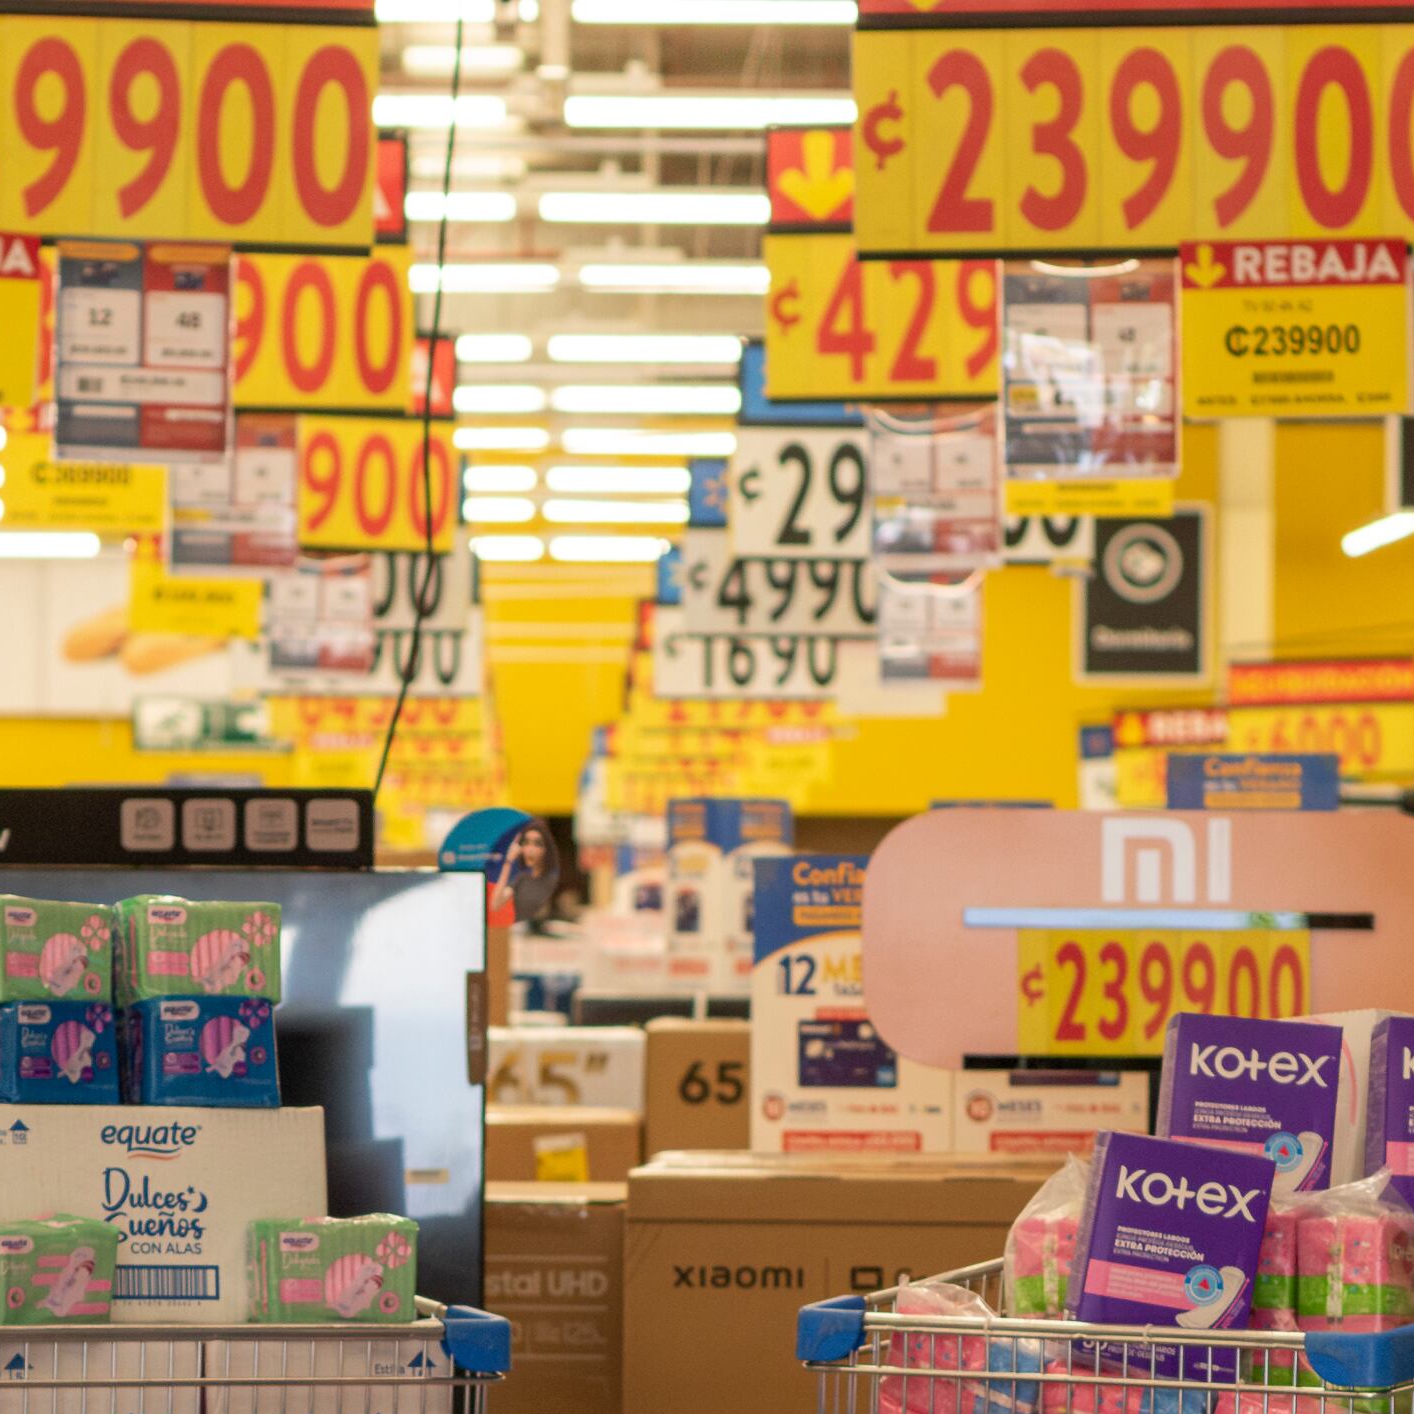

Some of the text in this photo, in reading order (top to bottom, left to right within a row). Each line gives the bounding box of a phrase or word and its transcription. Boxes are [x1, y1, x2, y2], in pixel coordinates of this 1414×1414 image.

[1232, 244, 1400, 283] REBAJA
[779, 954, 818, 996] 12
[679, 1061, 744, 1106] 65
[99, 1120, 198, 1154] equate
[1193, 1114, 1282, 1130] EXTRA PROTECCIÓN
[101, 1167, 190, 1214] Dulces
[130, 1240, 203, 1255] CON ALAS
[1115, 1239, 1205, 1263] EXTRA PROTECCIÓN
[547, 1269, 608, 1297] UHD
[673, 1263, 804, 1291] xiaomi
